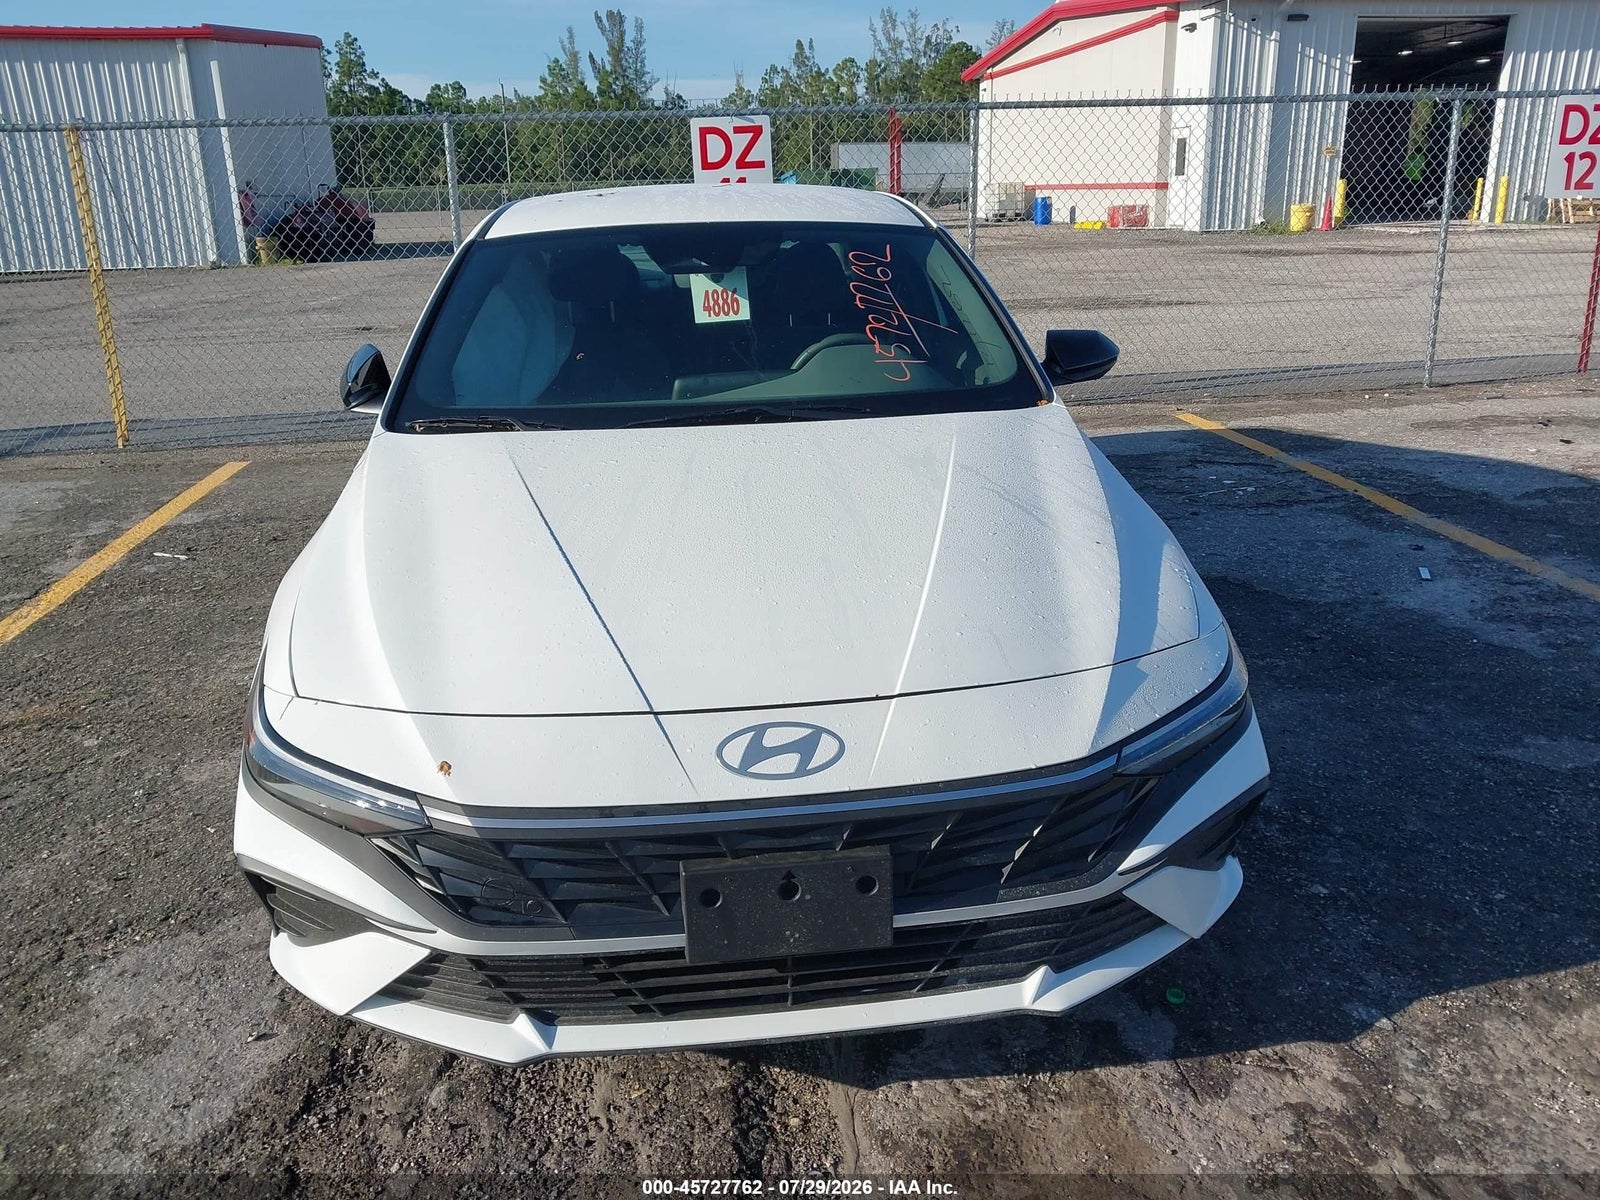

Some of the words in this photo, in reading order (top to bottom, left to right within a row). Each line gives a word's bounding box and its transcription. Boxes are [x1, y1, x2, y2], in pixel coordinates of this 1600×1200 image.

[698, 124, 766, 170] DZ
[1563, 151, 1597, 190] 12
[702, 287, 741, 318] 4886
[848, 243, 959, 382] 45727762
